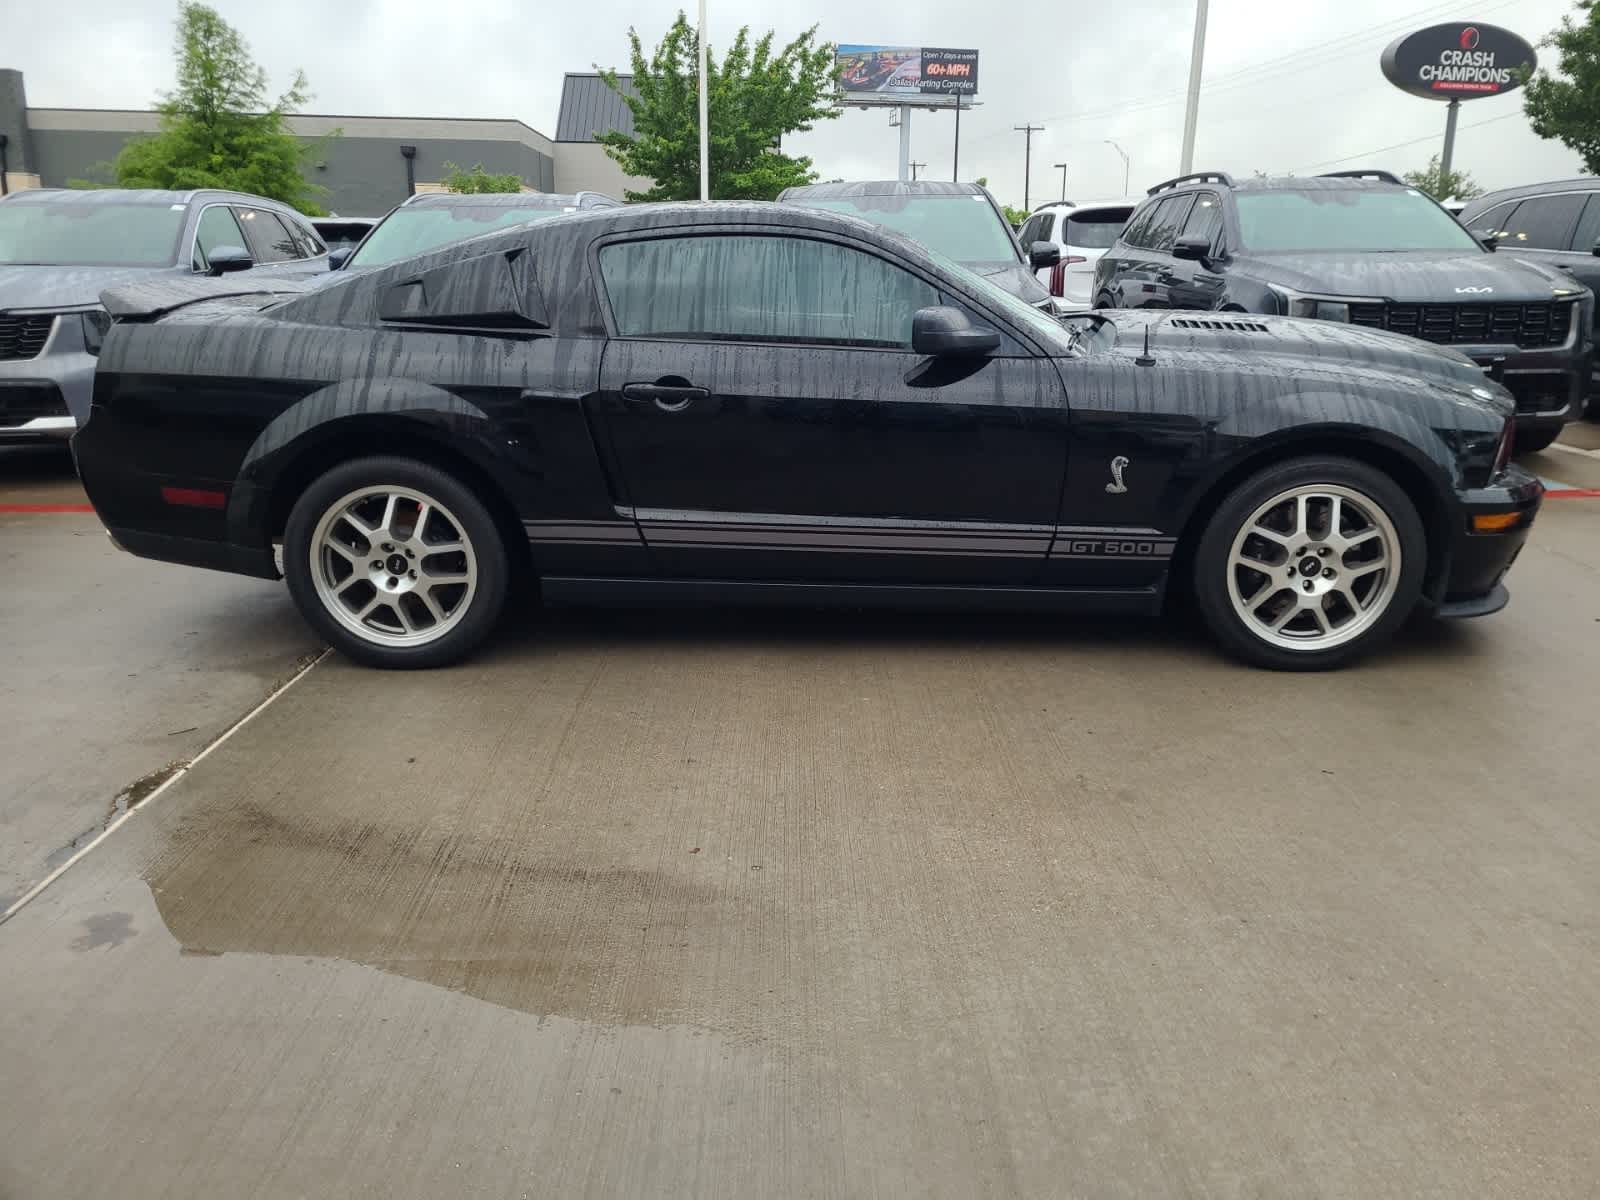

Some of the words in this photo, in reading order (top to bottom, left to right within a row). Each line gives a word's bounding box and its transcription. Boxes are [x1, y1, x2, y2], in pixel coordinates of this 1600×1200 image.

[923, 51, 939, 59] Open
[1440, 50, 1495, 67] CRASH
[927, 63, 946, 75] 60+
[946, 63, 970, 76] MPH
[1419, 65, 1511, 83] CHAMPIONS
[1071, 541, 1102, 553] GT
[1104, 541, 1152, 554] 500
